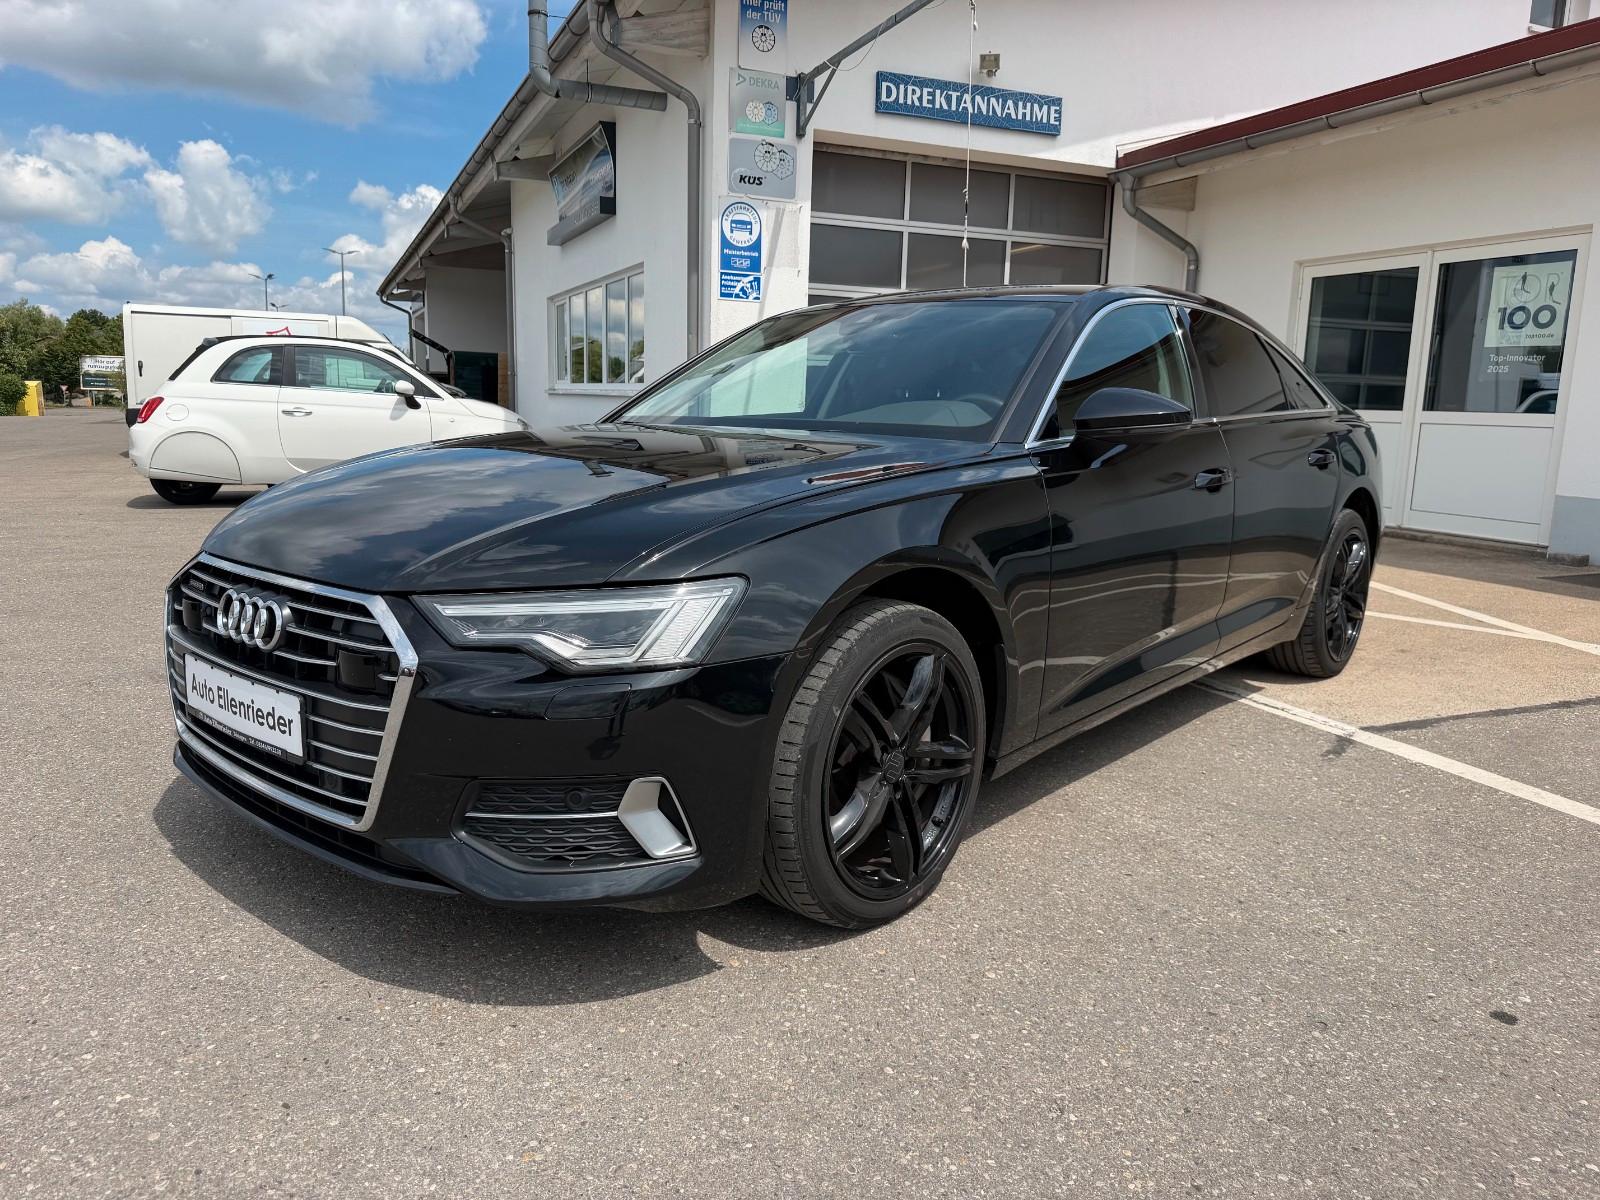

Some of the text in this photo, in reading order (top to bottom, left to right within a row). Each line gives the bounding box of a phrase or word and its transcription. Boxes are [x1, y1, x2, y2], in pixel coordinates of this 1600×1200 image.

[746, 8, 781, 24] der TÜV
[749, 76, 780, 91] DEKRA
[881, 81, 1061, 125] DIREKTANNAHME
[739, 174, 763, 186] KÜS
[1498, 304, 1557, 331] 100
[1489, 353, 1547, 363] Top-Innovator
[1487, 365, 1509, 373] 2025
[191, 673, 294, 737] Auto Ellenrieder
